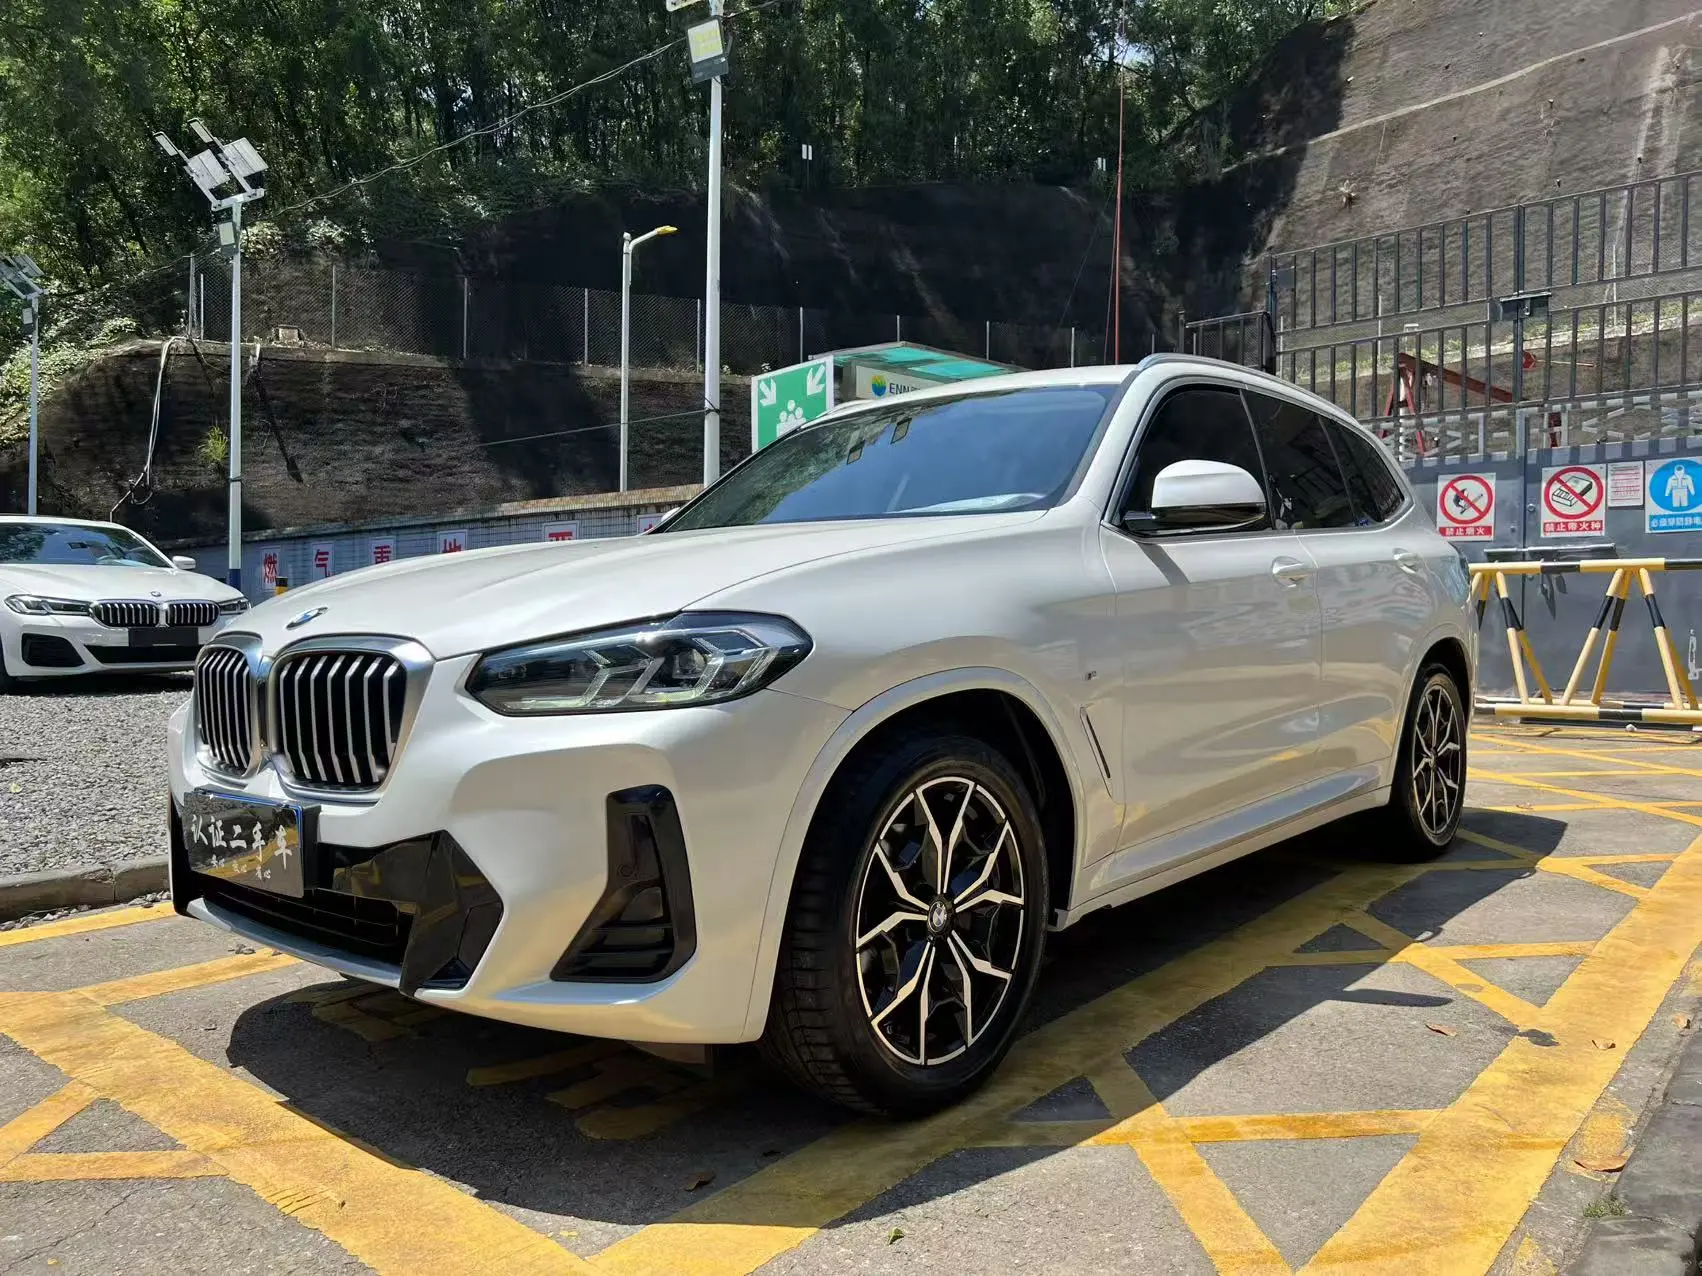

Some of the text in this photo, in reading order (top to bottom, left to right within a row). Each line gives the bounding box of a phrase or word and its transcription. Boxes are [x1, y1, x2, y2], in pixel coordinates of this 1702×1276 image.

[889, 382, 910, 395] ENN
[1445, 526, 1485, 536] 禁止烟火
[1544, 520, 1602, 532] 禁止带火种
[191, 814, 293, 870] 认证二手车
